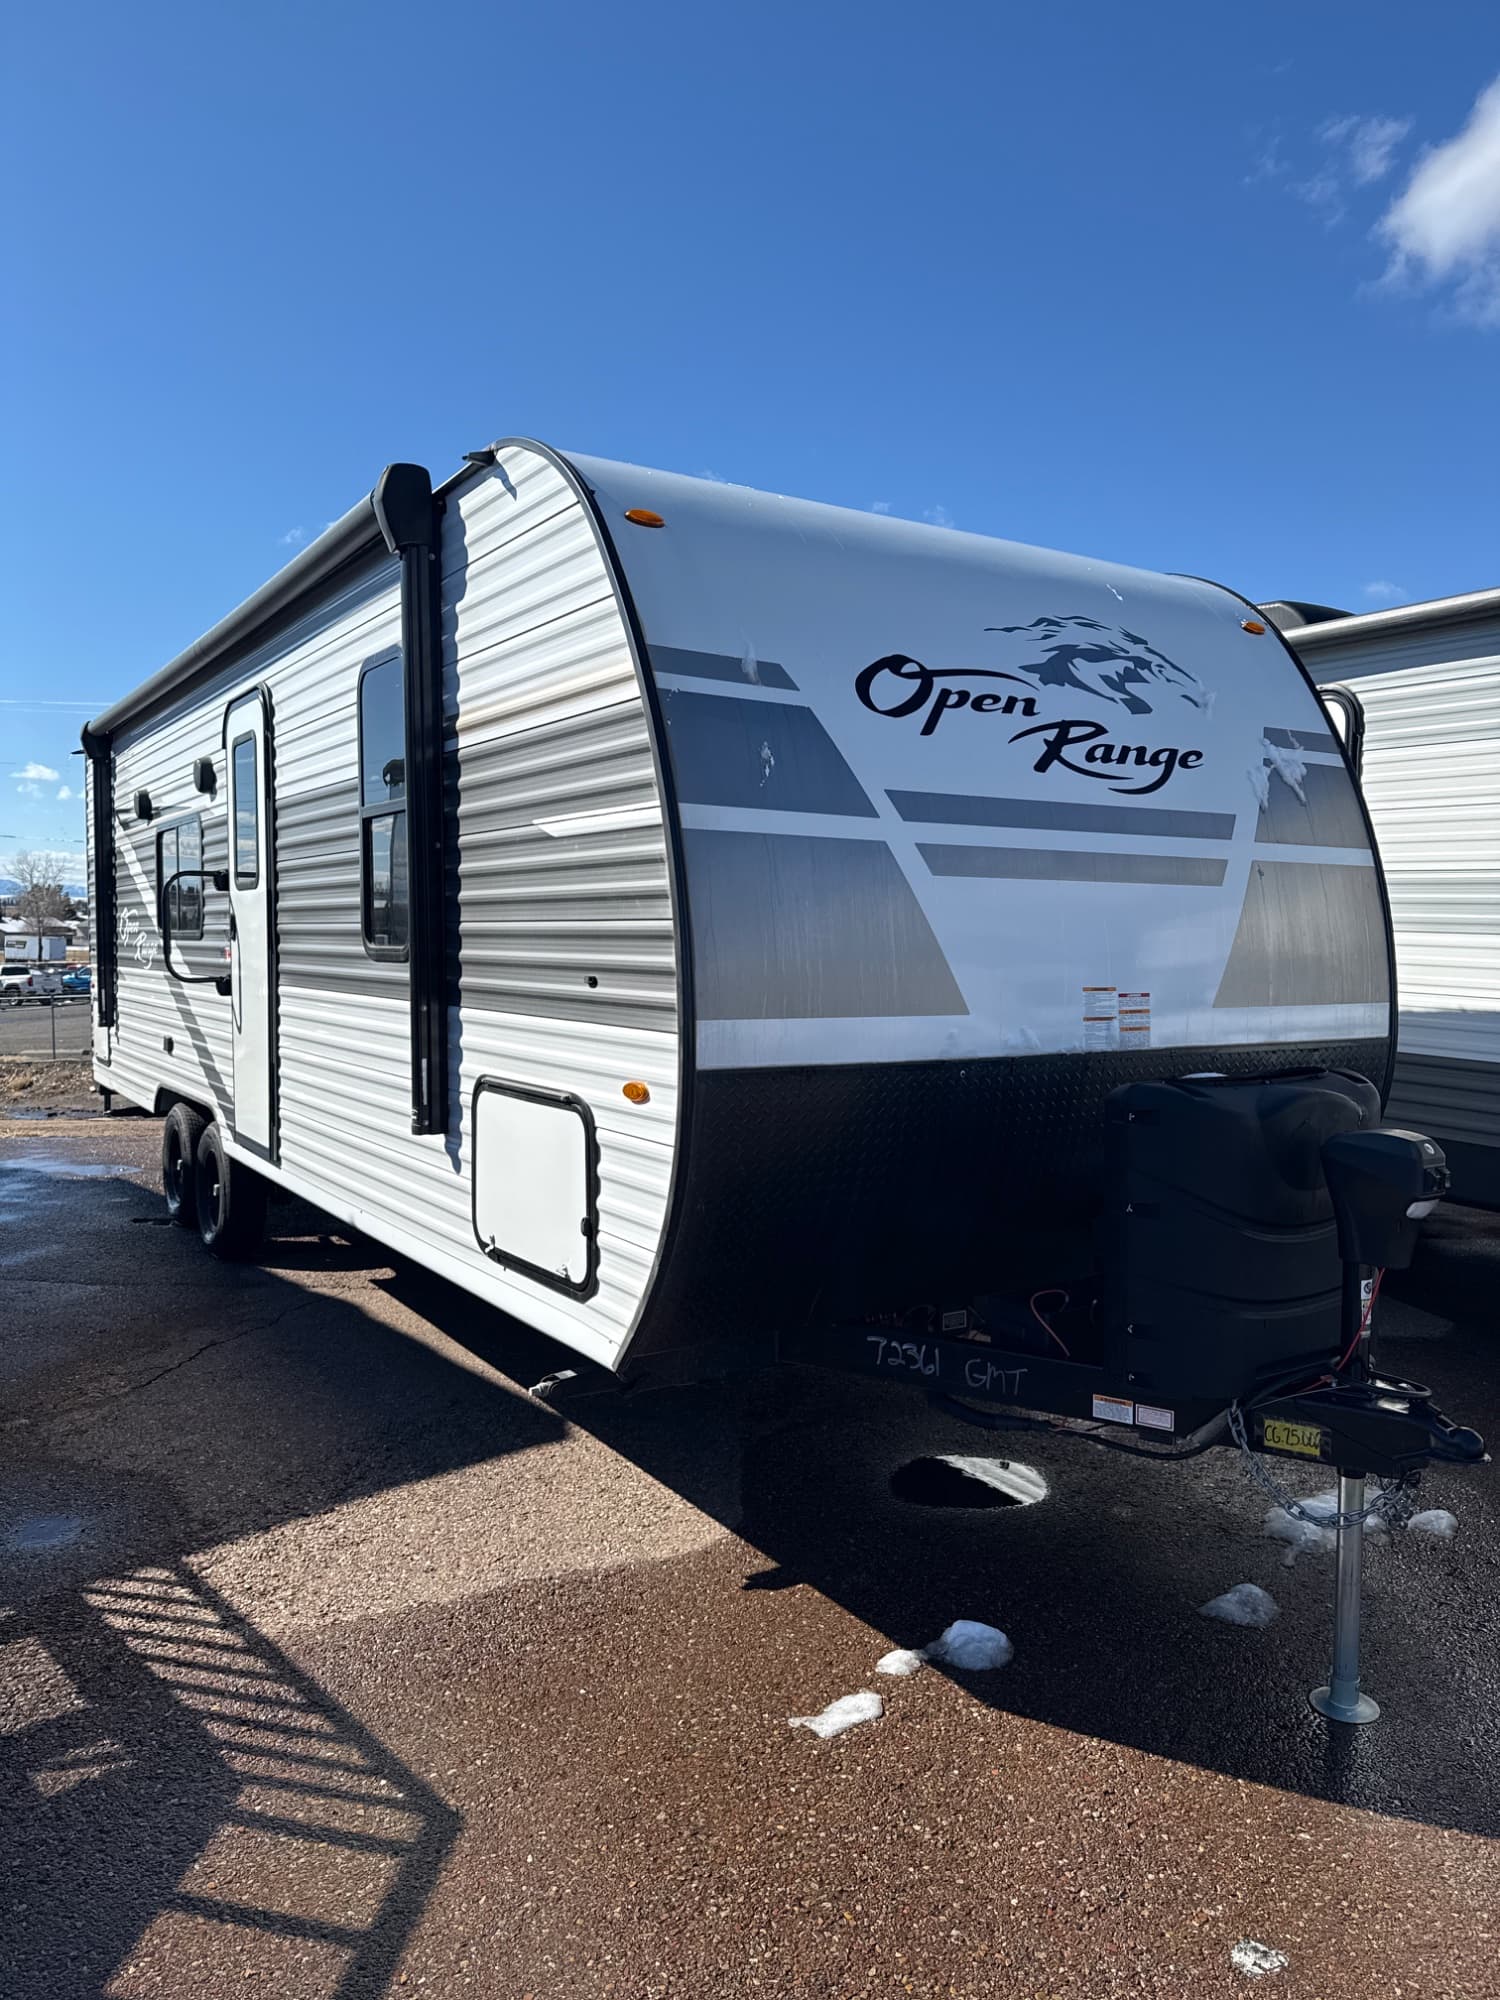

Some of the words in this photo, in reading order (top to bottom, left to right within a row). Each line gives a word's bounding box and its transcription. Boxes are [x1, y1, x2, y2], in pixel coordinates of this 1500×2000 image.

[854, 653, 1040, 736] Open
[1007, 719, 1204, 795] Range
[865, 1335, 940, 1377] 72361
[964, 1358, 1029, 1396] GMT
